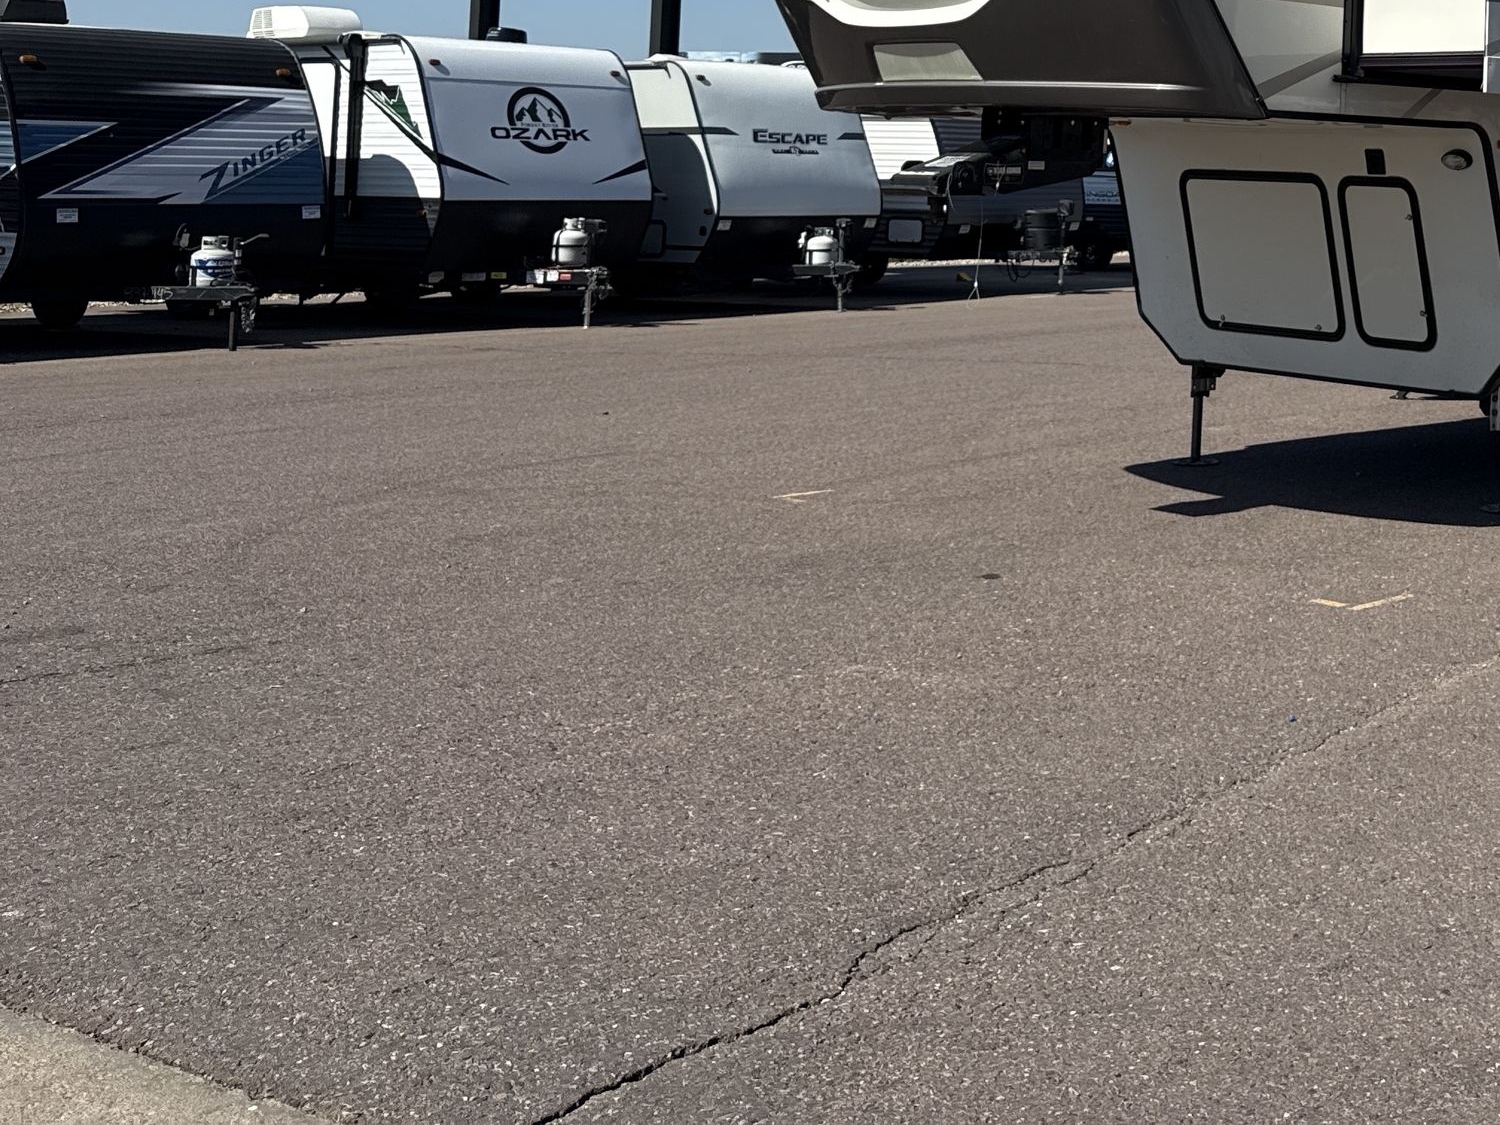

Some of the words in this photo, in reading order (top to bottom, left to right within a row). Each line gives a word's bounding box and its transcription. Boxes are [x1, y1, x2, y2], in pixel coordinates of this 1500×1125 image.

[490, 127, 590, 141] OZARK
[752, 128, 828, 145] ESCAPE
[199, 128, 306, 203] ZINGER
